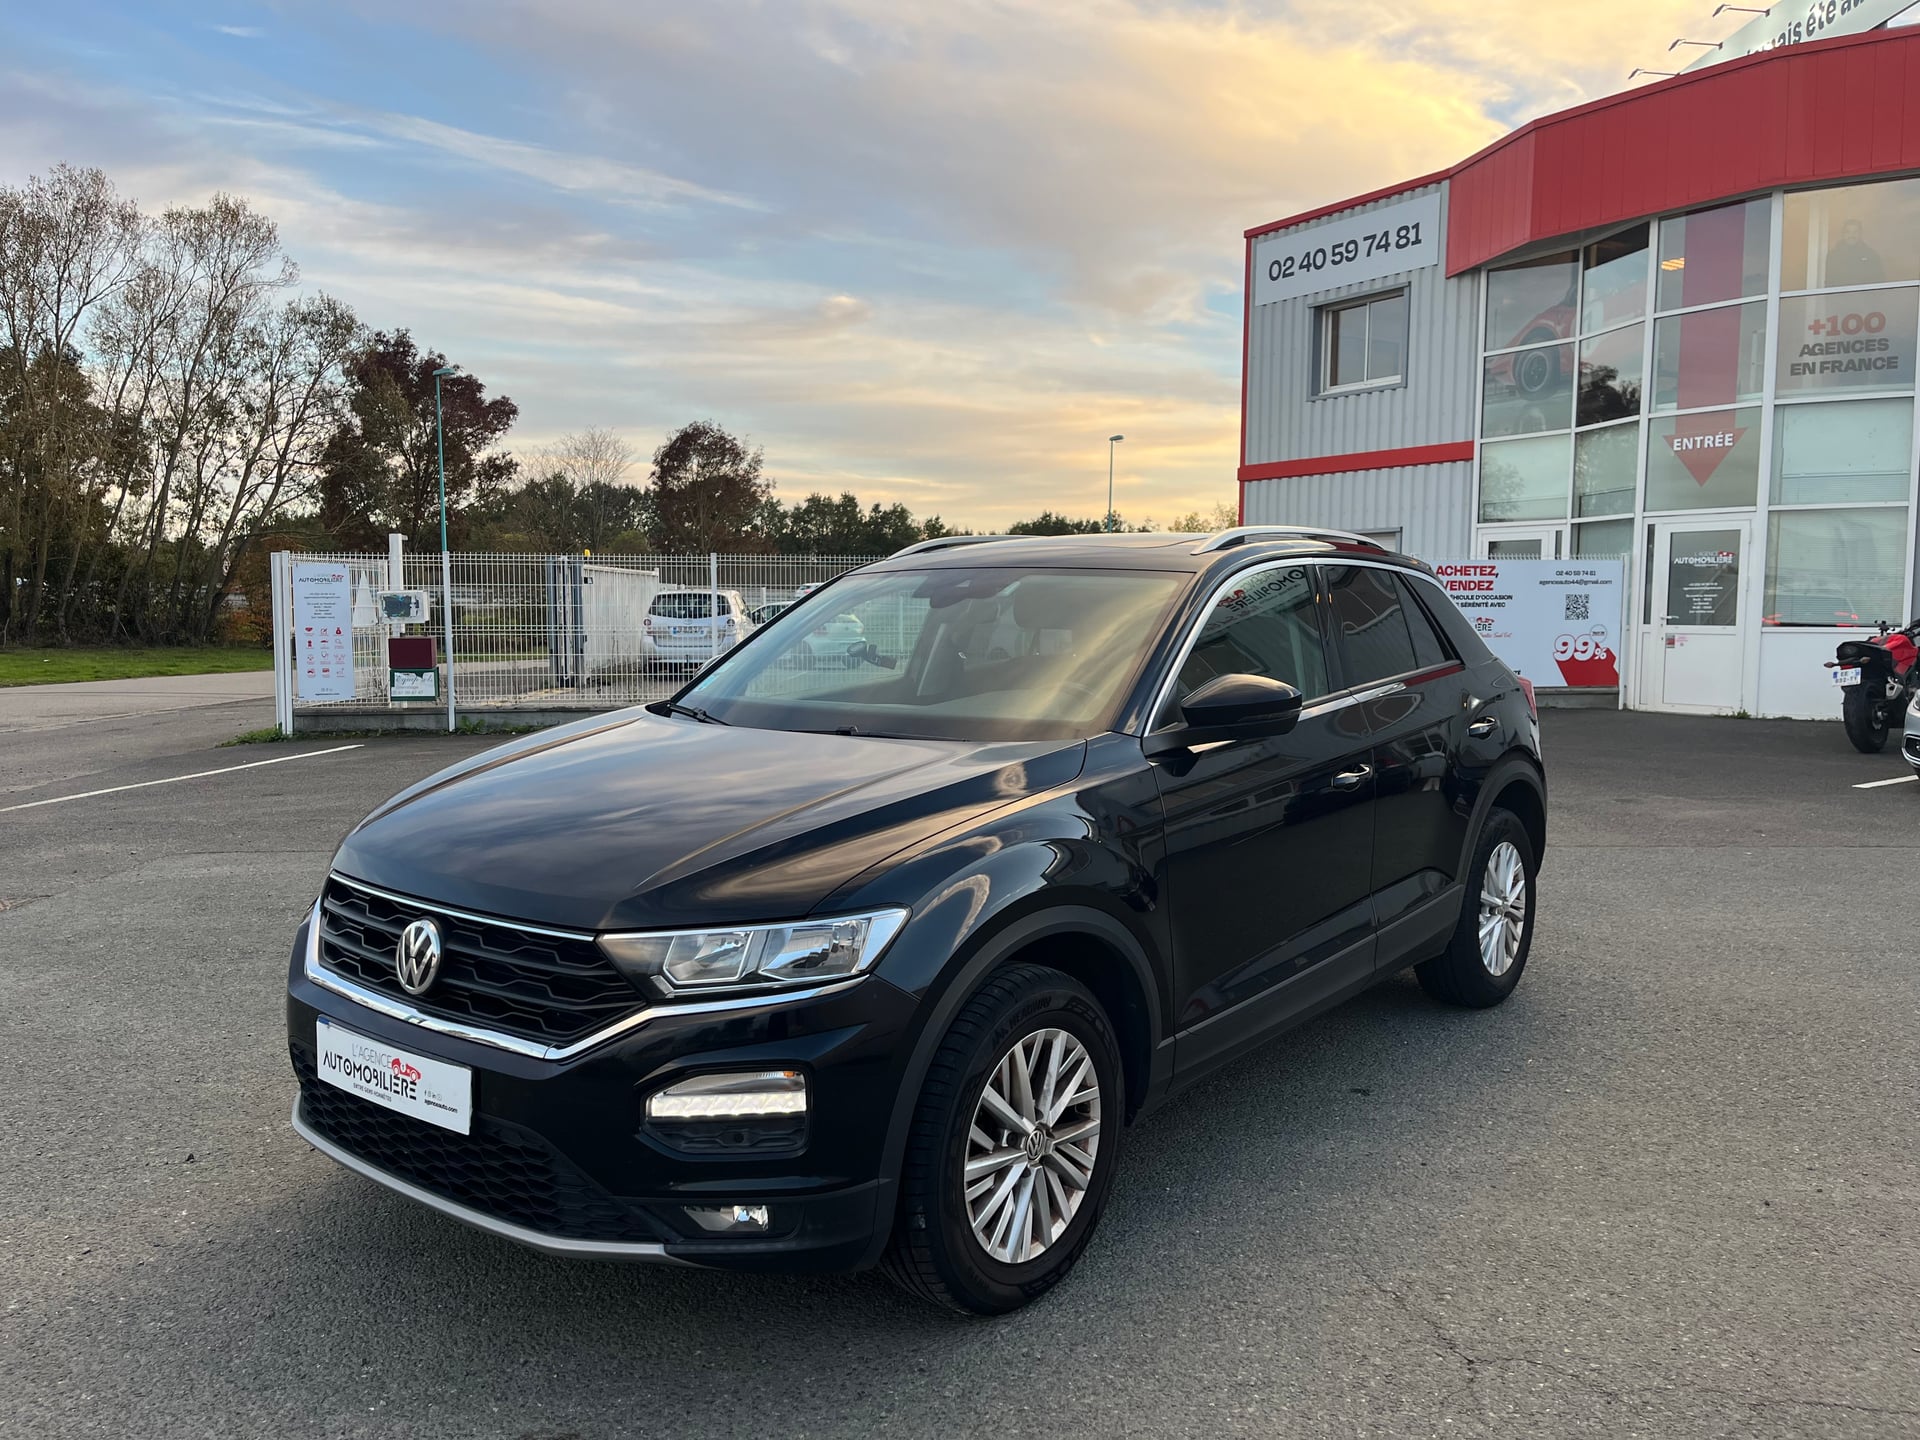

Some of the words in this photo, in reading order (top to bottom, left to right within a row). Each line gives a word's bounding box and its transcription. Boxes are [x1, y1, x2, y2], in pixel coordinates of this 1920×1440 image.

[1268, 256, 1295, 282] 02
[1298, 248, 1327, 272] 40
[1331, 239, 1359, 266] 59
[1363, 230, 1390, 257] 74
[1395, 222, 1422, 250] 81
[1808, 311, 1886, 336] +100
[1799, 337, 1890, 357] AGENCES
[1790, 362, 1816, 376] EN
[1819, 356, 1899, 374] FRANCE
[1673, 432, 1734, 451] ENTRÉE
[1436, 565, 1499, 578] ACHETEZ,
[351, 1043, 392, 1069] L'AGENCE
